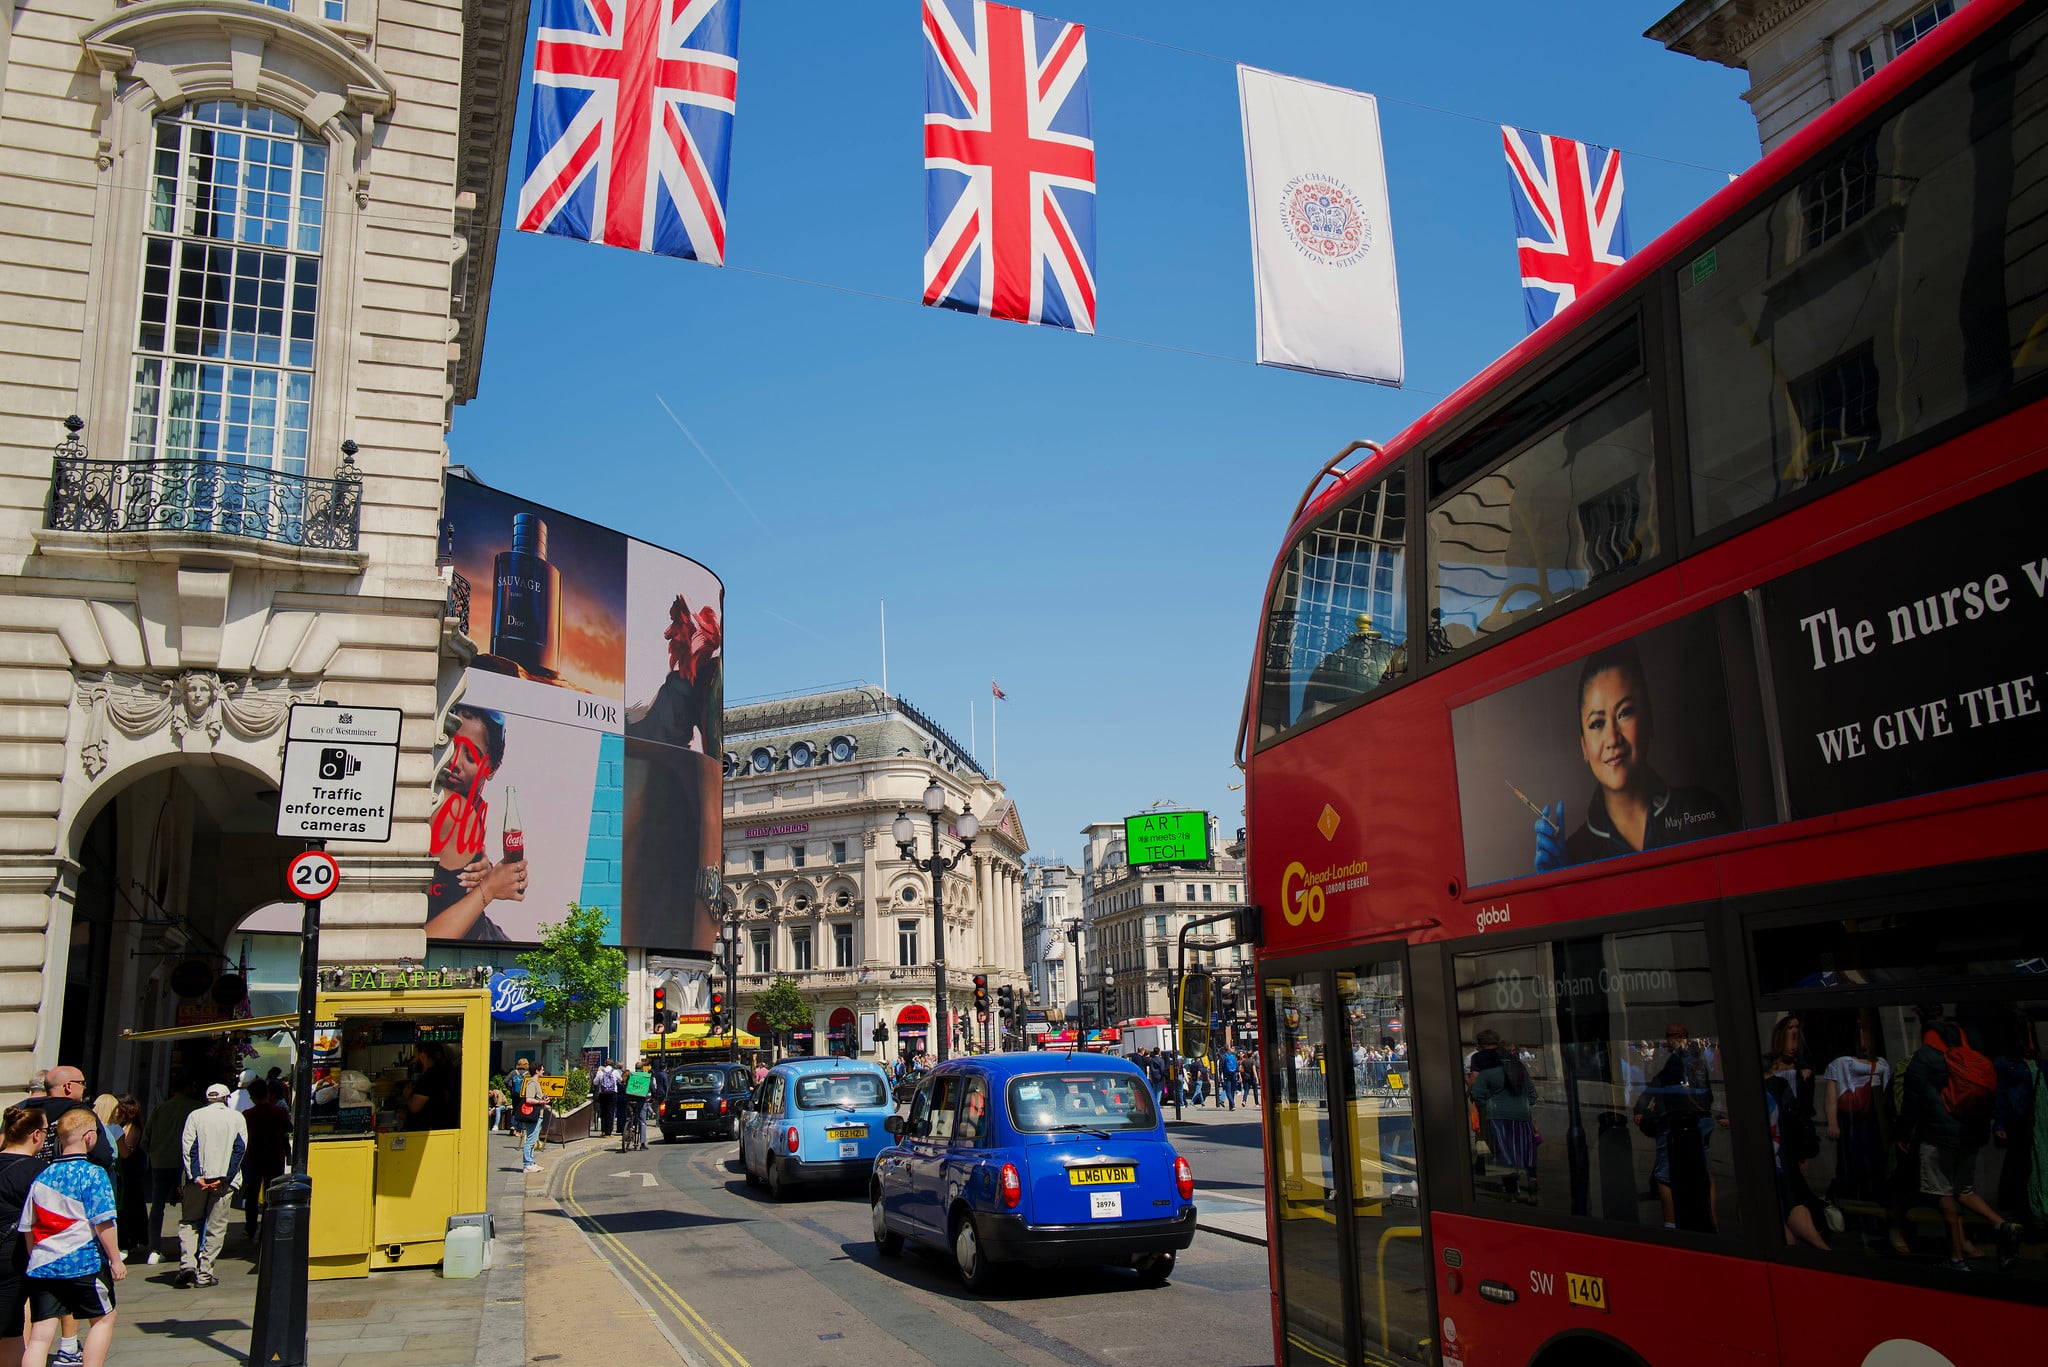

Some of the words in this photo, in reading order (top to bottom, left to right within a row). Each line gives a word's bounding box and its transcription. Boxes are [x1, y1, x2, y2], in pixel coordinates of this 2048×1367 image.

[1283, 175, 1304, 195] KING
[1305, 172, 1352, 195] CHARLES
[1280, 202, 1324, 265] CORONATION
[498, 575, 541, 593] SAUVAGE
[1800, 607, 1876, 671] The
[1887, 573, 2011, 646] nurse
[577, 699, 617, 724] DIOR
[1816, 721, 1866, 765] WE
[1873, 699, 1953, 751] GIVE
[1959, 675, 2041, 729] THE
[311, 726, 324, 736] City
[326, 727, 334, 735] of
[335, 728, 378, 738] Westminster
[312, 787, 362, 801] Traffic
[285, 803, 385, 818] enforcement
[300, 819, 366, 833] cameras
[1144, 815, 1183, 832] ART
[1665, 816, 1683, 831] May
[1683, 811, 1716, 825] Parsons
[1150, 833, 1177, 842] meets
[1145, 844, 1185, 860] TECH
[296, 865, 332, 885] 20
[1325, 881, 1346, 895] LONDON
[1347, 875, 1370, 890] GENERAL
[1281, 861, 1325, 926] Go
[1303, 860, 1368, 887] Ahead-London
[1476, 903, 1511, 934] global
[350, 971, 453, 990] FALAFEL
[1496, 968, 1524, 1010] 88
[1532, 971, 1594, 1004] Clapham
[1598, 967, 1673, 994] Common
[690, 1039, 707, 1047] DOG
[1077, 1169, 1103, 1182] LM61
[1105, 1168, 1128, 1181] VBN
[1529, 1269, 1554, 1296] SW
[1571, 1278, 1601, 1302] 140
